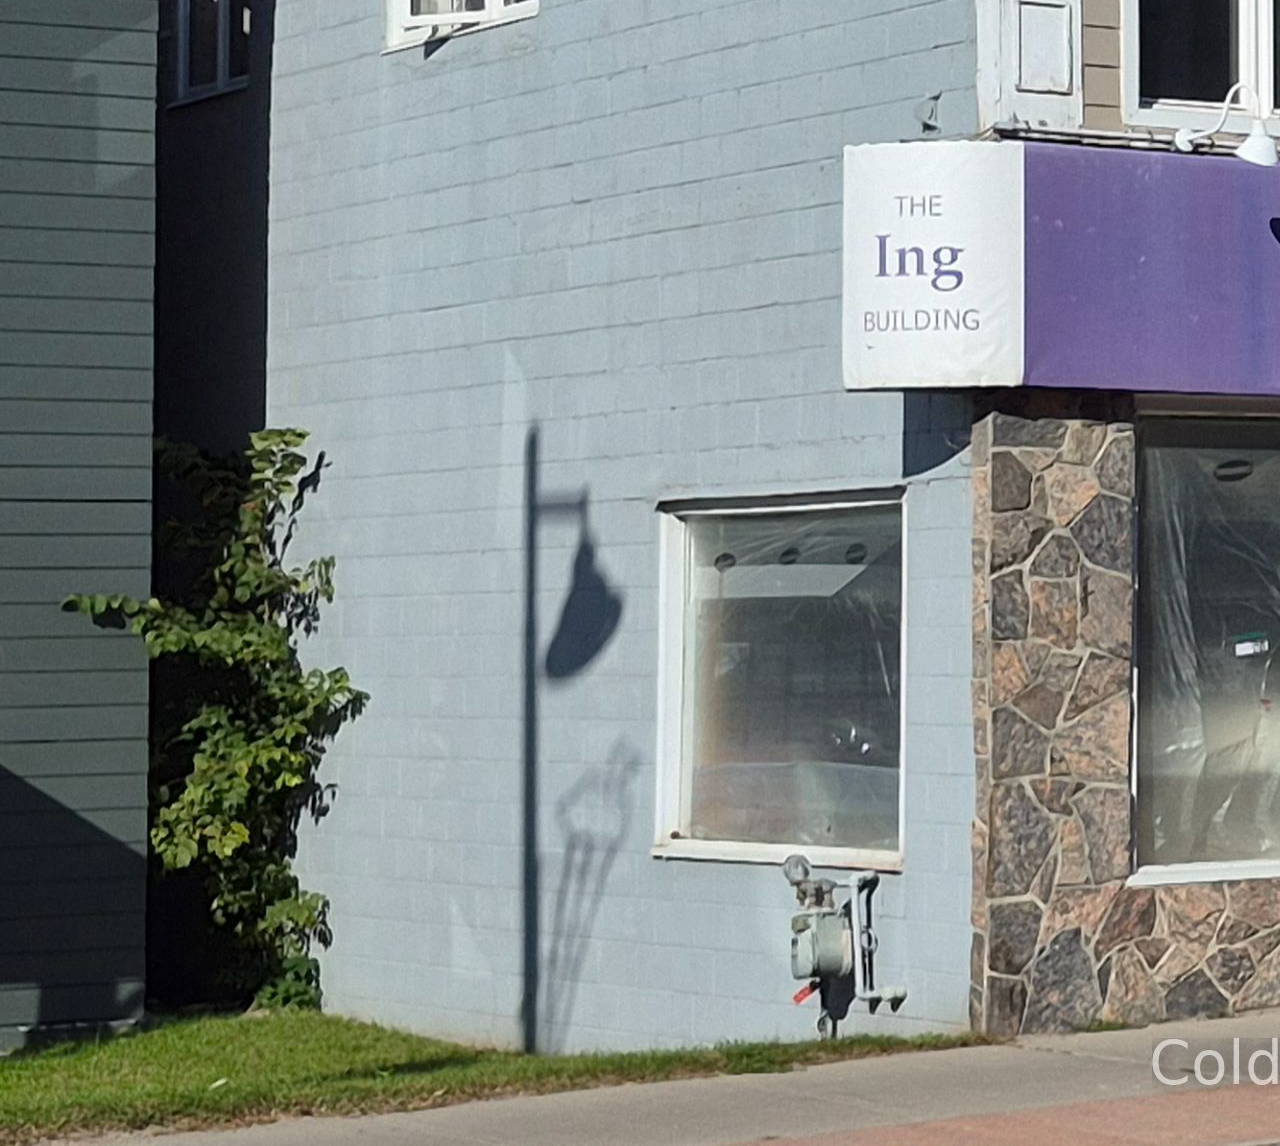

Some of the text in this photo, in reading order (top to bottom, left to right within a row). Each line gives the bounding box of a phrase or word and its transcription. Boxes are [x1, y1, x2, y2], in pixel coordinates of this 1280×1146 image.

[894, 194, 943, 217] THE
[874, 233, 965, 292] Ing
[863, 307, 981, 332] BUILDING
